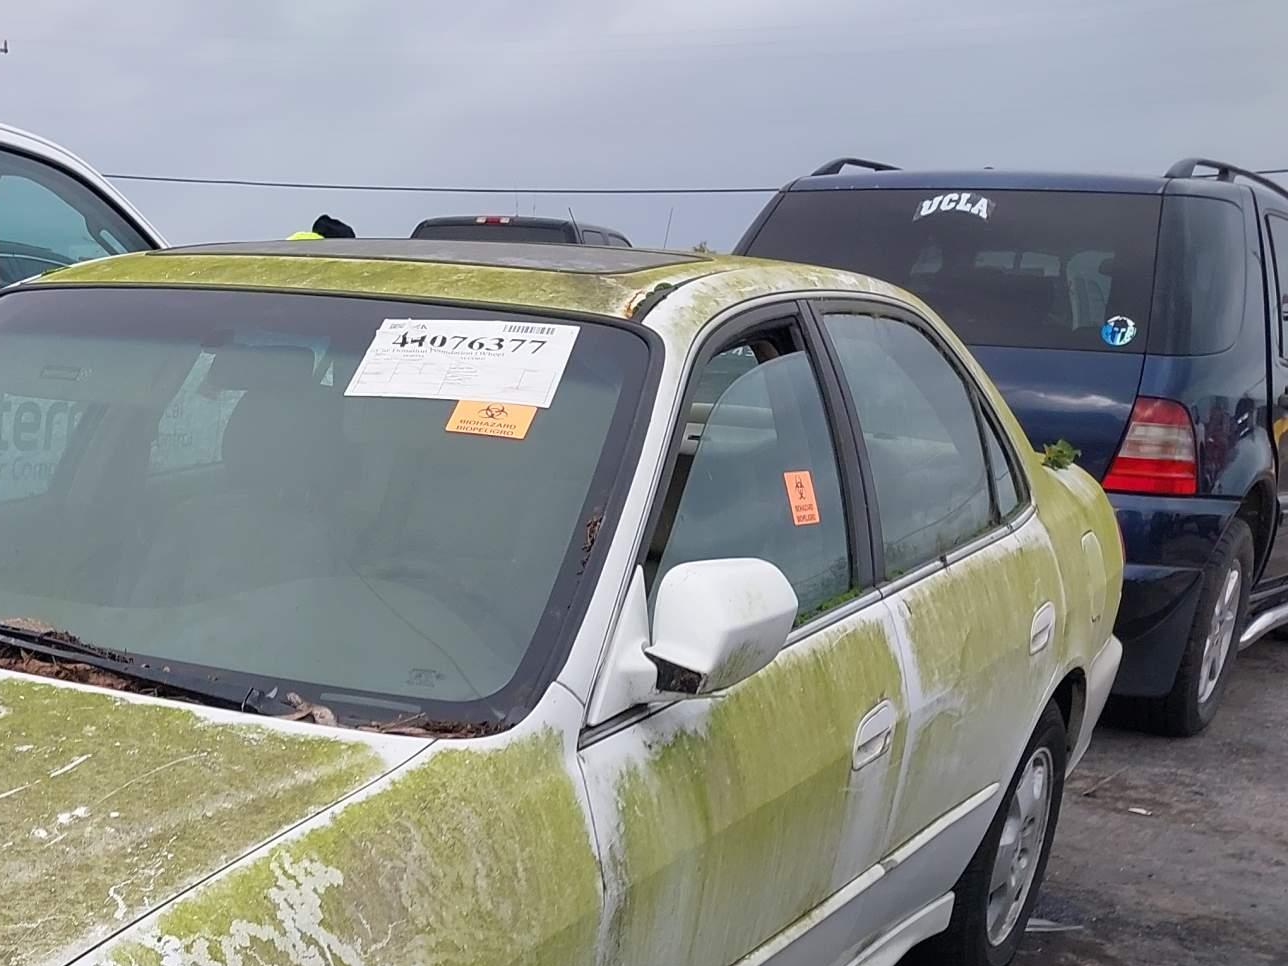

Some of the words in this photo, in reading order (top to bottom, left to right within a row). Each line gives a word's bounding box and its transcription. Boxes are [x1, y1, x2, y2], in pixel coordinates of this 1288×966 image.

[920, 193, 988, 219] UCLA
[392, 331, 548, 354] 44076377
[459, 419, 517, 430] BIOHAZARD
